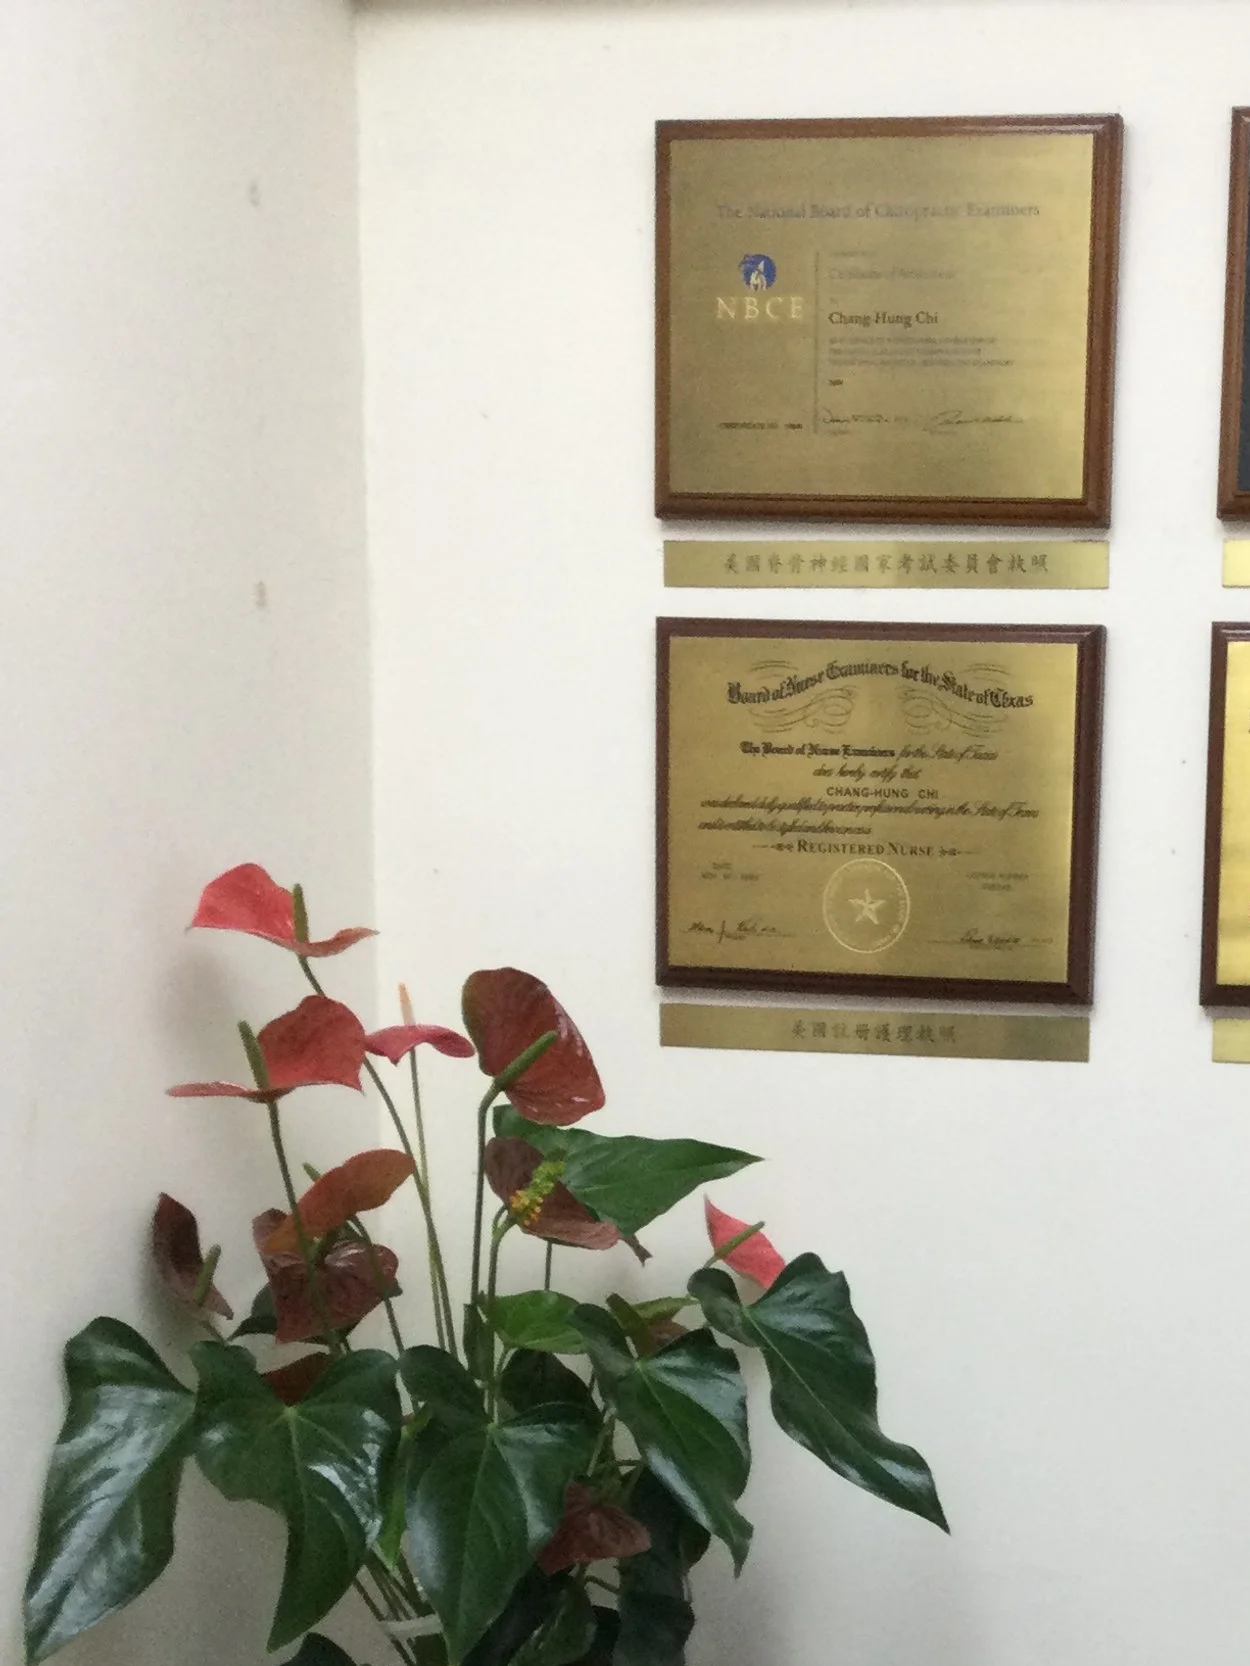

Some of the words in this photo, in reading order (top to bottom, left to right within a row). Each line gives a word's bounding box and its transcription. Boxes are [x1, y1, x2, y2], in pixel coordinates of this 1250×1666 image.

[716, 296, 804, 319] NBCE
[875, 311, 912, 328] Hung
[915, 310, 938, 324] Chi
[990, 687, 1034, 709] Texas
[826, 786, 909, 799] CHANG-HUNG
[918, 788, 940, 800] CHI
[797, 839, 885, 855] REGISTERED
[888, 841, 934, 857] NURSE
